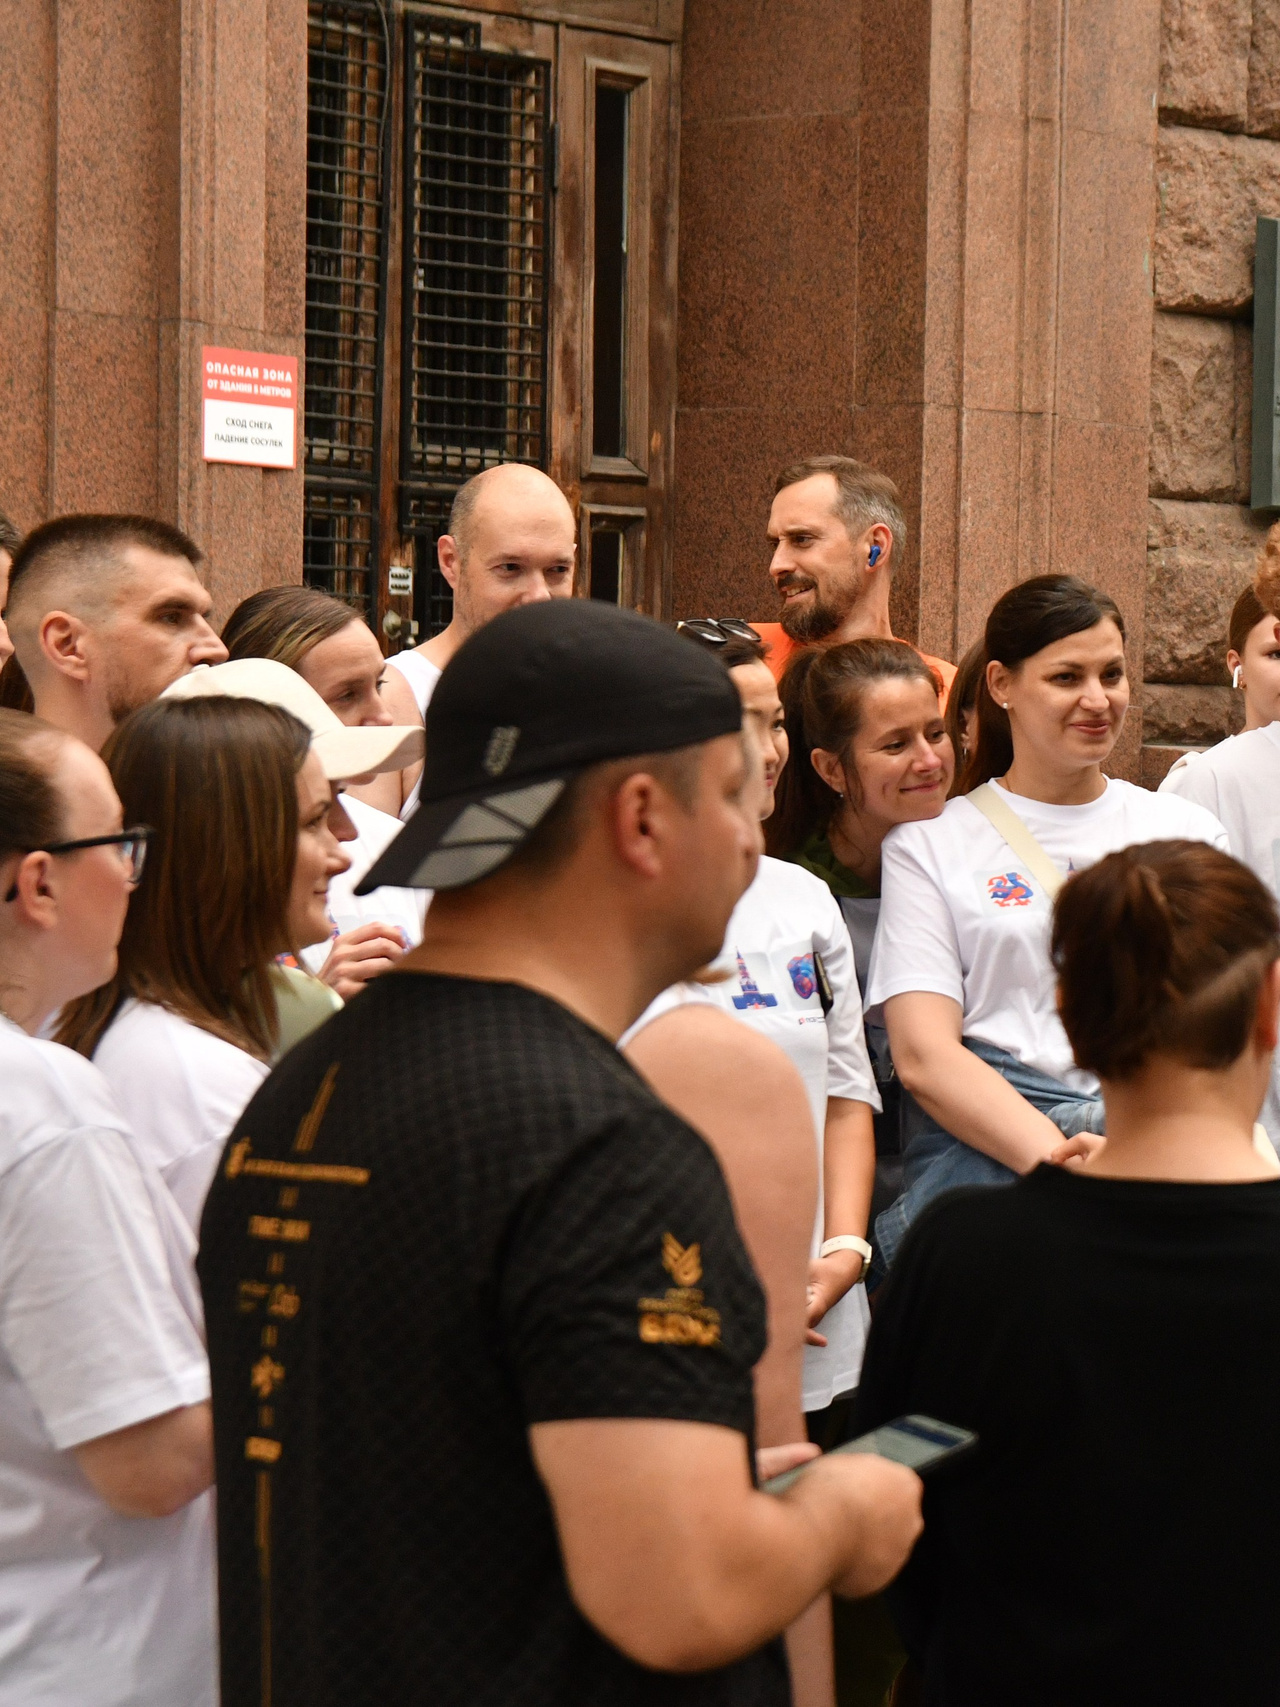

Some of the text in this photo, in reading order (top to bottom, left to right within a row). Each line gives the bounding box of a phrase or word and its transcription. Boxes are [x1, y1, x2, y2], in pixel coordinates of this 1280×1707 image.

[205, 361, 293, 383] ОПАСНАЯ ЗОНА
[207, 378, 218, 390] ОТ
[259, 384, 292, 399] МЕТРОВ
[225, 417, 273, 431] СХОД СНЕГА
[214, 433, 283, 448] ПАДЕНИЕ СОСУЛЕК
